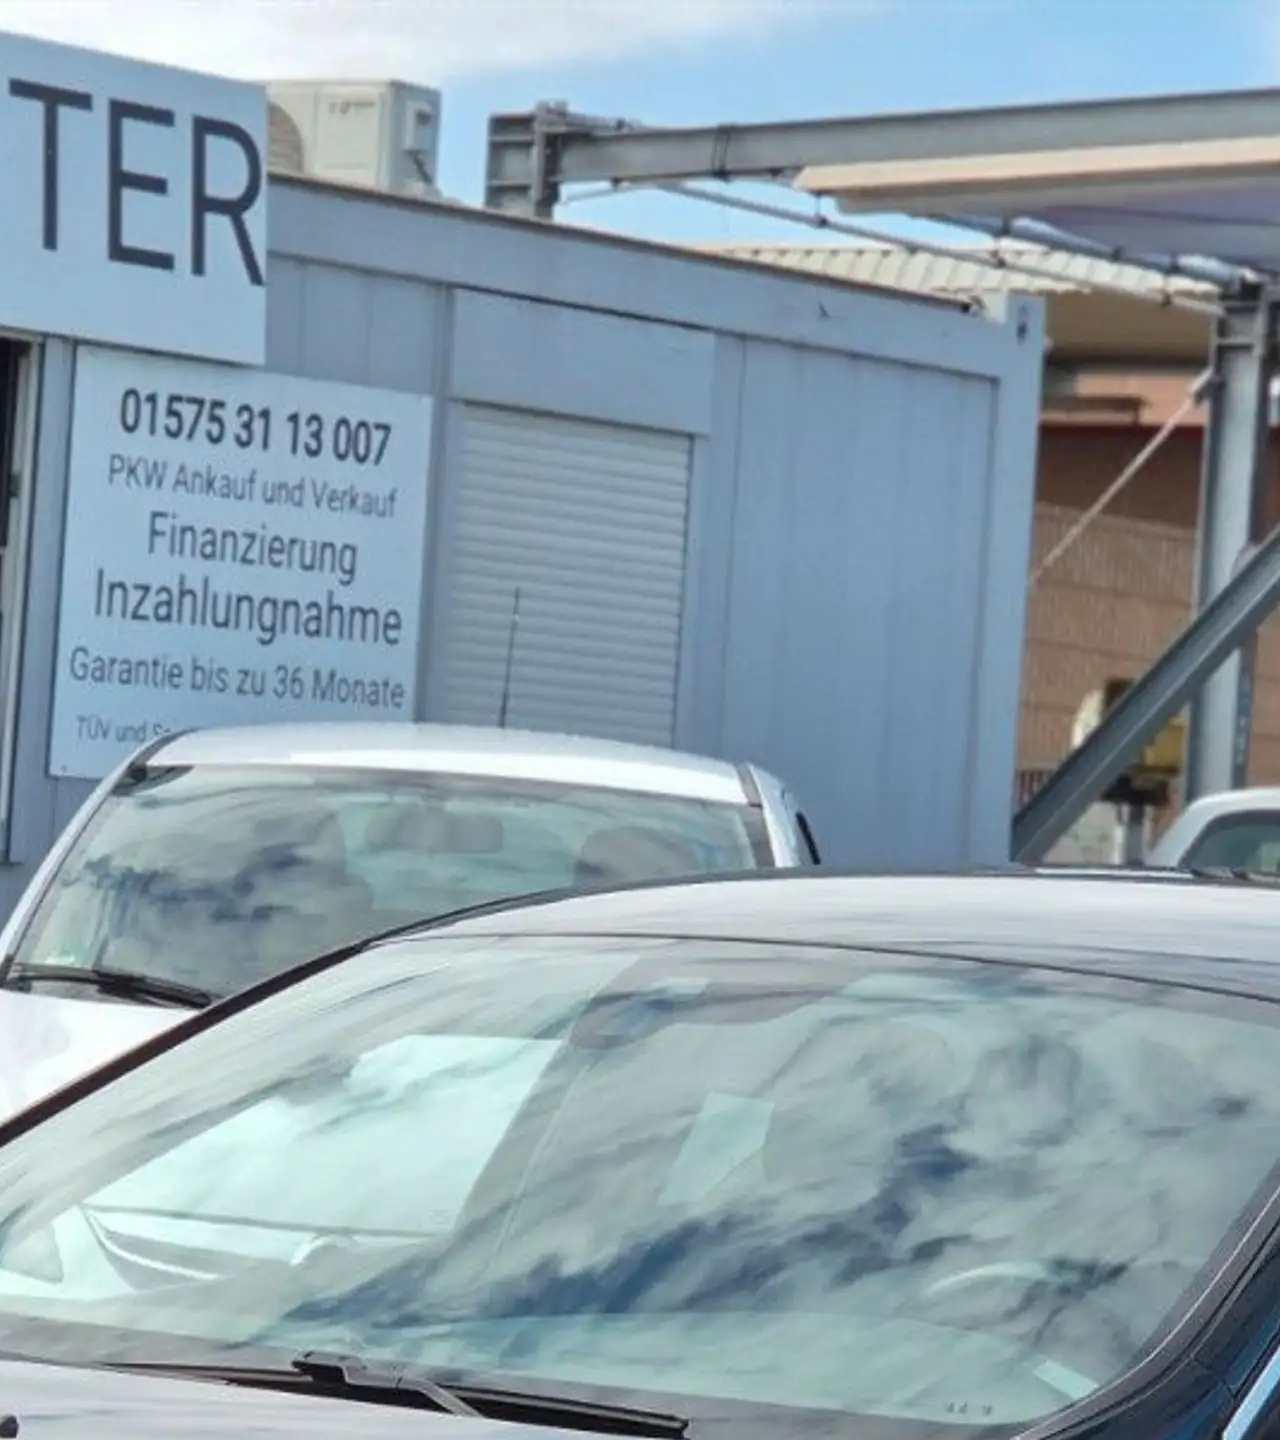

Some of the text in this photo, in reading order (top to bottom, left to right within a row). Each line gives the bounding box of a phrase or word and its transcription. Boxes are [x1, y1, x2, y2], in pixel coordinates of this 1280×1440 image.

[121, 388, 392, 467] 01575 31 13 007
[107, 452, 398, 519] PKW Ankauf und Verkauf
[148, 510, 358, 587] Finanzierung
[94, 568, 402, 647] Inzahlungnahme
[70, 645, 406, 709] Garantie bis zu 36 Monate
